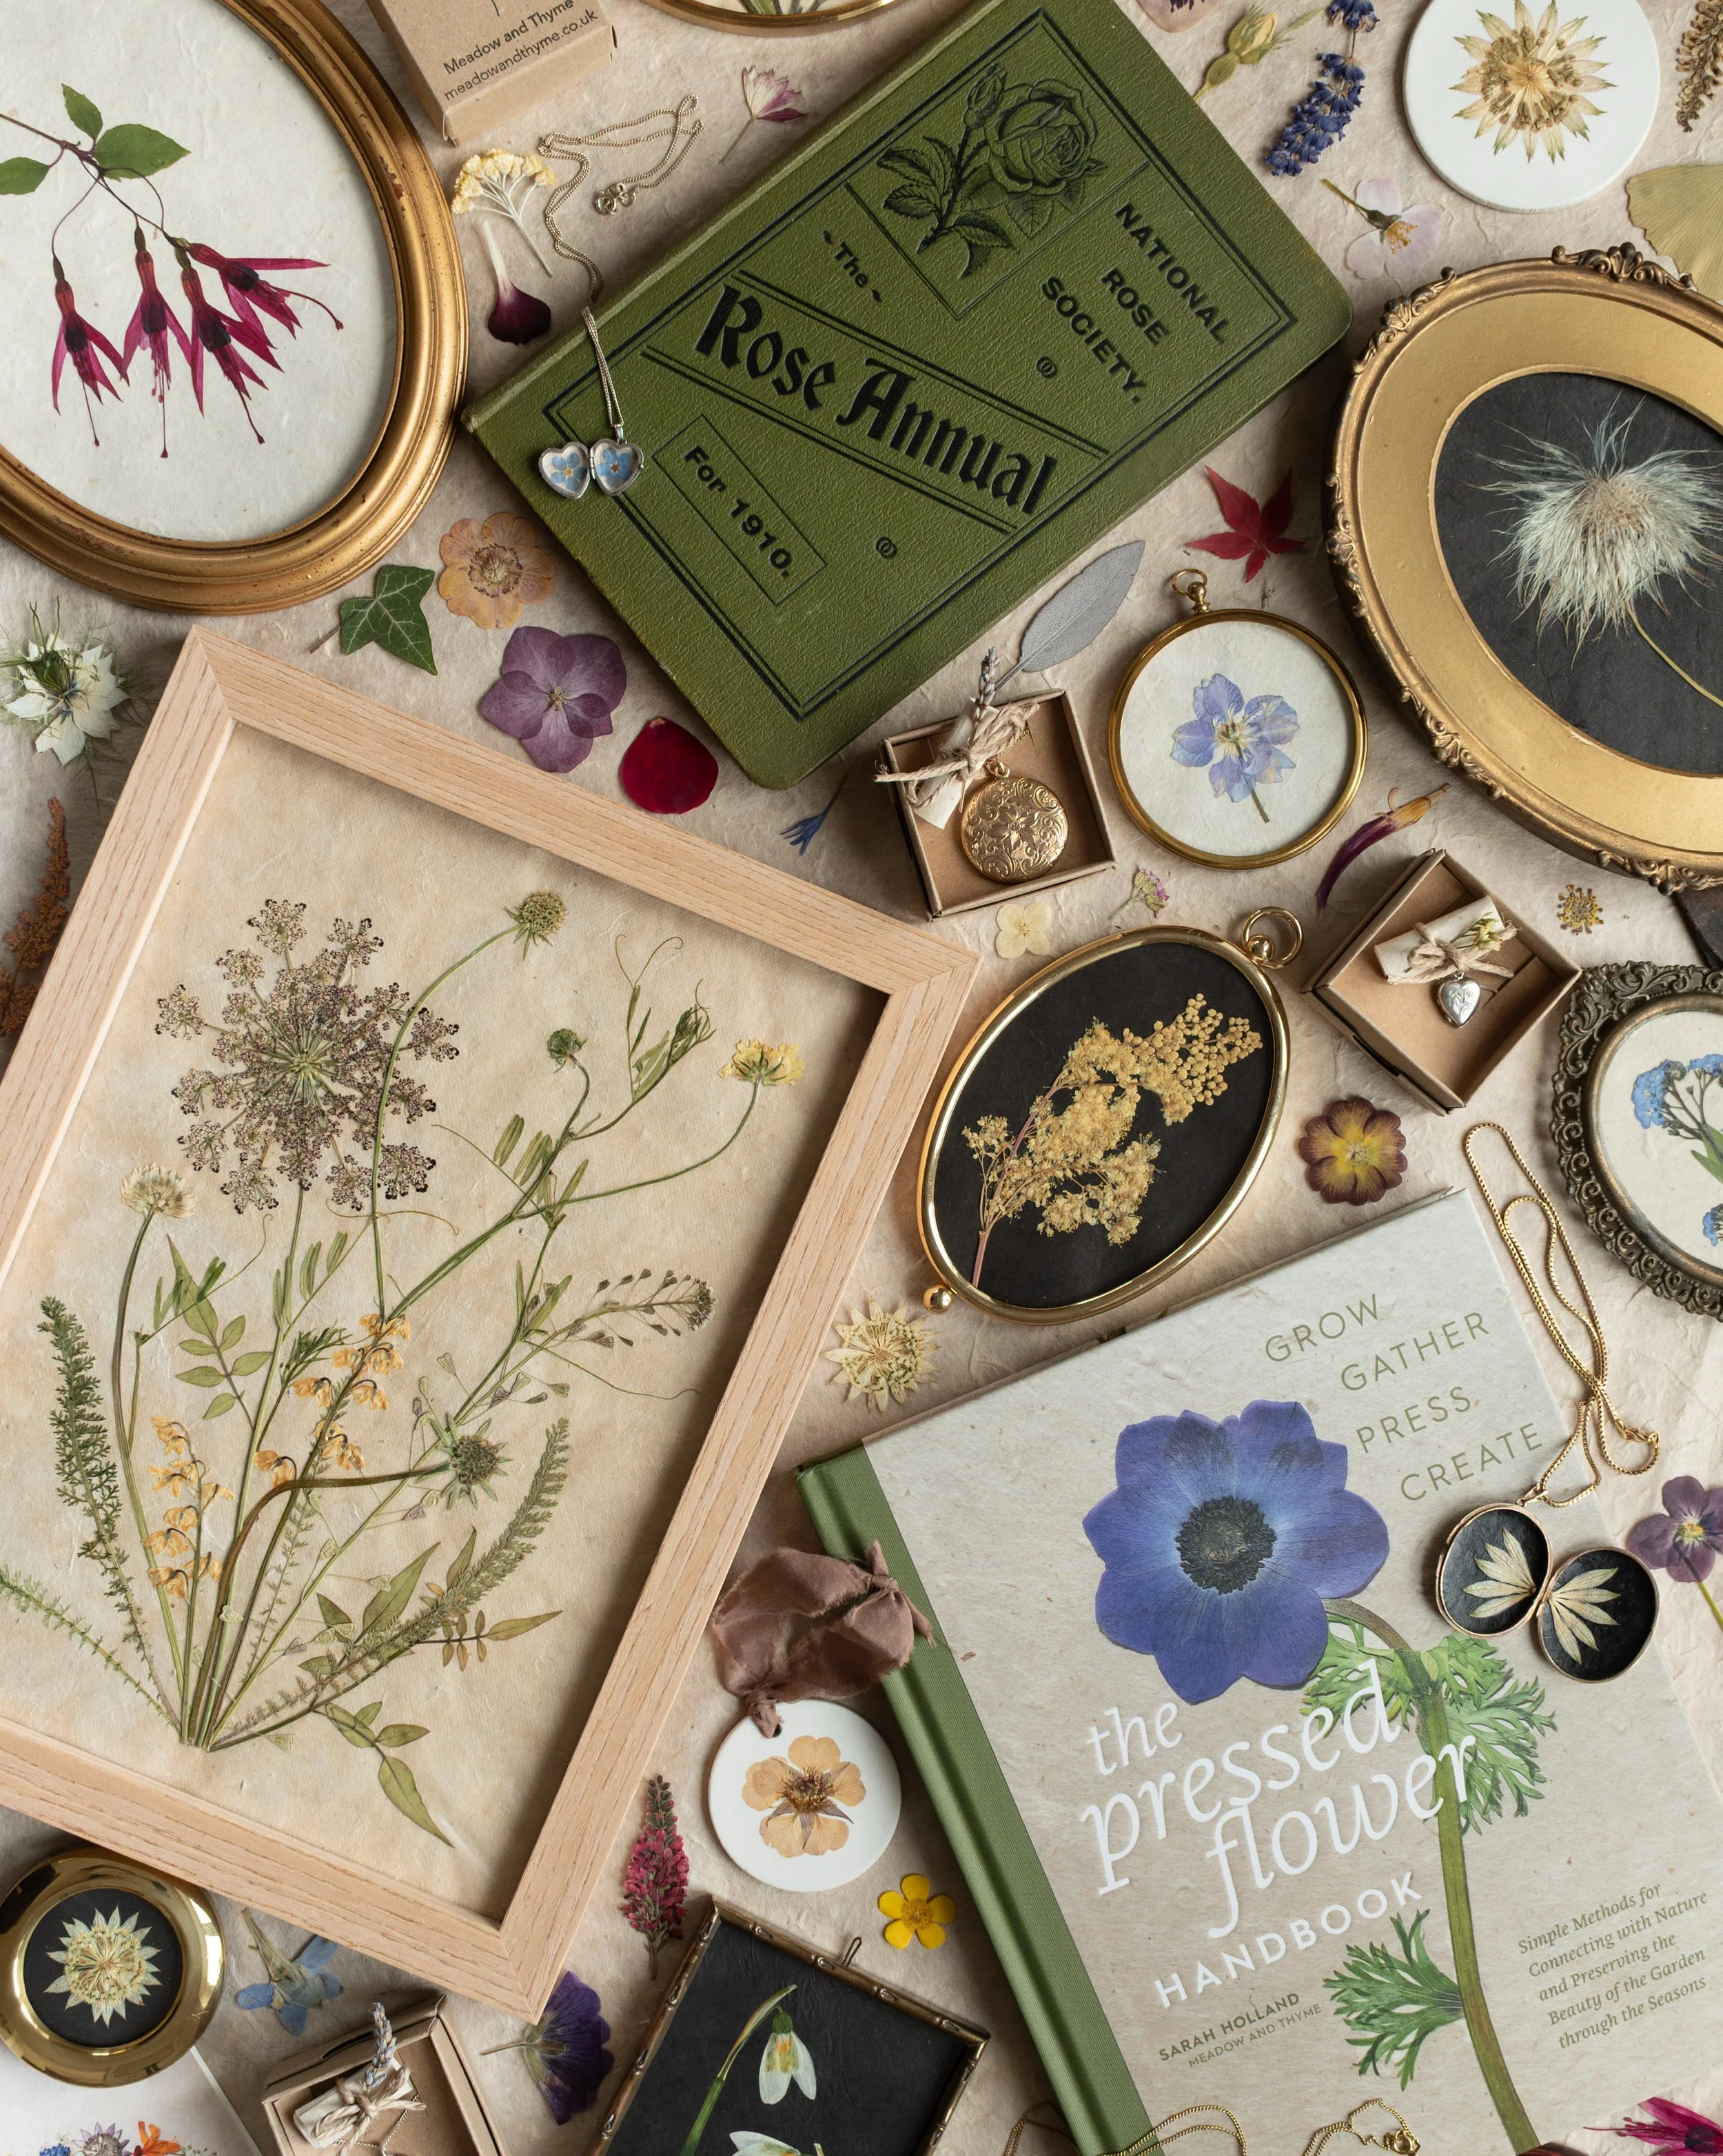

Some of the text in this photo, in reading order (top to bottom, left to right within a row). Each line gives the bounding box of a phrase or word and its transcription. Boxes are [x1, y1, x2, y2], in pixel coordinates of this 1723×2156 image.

[443, 0, 573, 75] Meadow and Thyme
[445, 10, 598, 101] meadowandthyme.co.uk
[833, 241, 870, 289] The
[1115, 203, 1228, 345] NATIONAL
[1041, 276, 1146, 404] SOCIETY.
[1101, 267, 1170, 345] ROSE
[693, 283, 1059, 516] Rose Annual
[683, 445, 794, 579] For 1910.
[1265, 1293, 1379, 1363] GROW
[1340, 1312, 1490, 1391] GATHER
[1356, 1386, 1471, 1454] PRESS
[1400, 1423, 1543, 1501] CREATE
[1080, 1657, 1404, 1896] pressed
[1086, 1701, 1184, 1776] the
[1205, 1735, 1476, 1939] flower
[1154, 1871, 1423, 2008] HANDBOOK
[1518, 1883, 1661, 1955] Simple Methods for
[1529, 1891, 1709, 1977] Connecting with Nature
[1539, 1934, 1676, 2002] and Preserving the
[1547, 1949, 1707, 2026] Beauty of the Garden
[1159, 1993, 1300, 2062] SARAH HOLLAND
[1187, 2003, 1323, 2068] MEADOW AND THYME
[1558, 1976, 1707, 2049] through the Seasons
